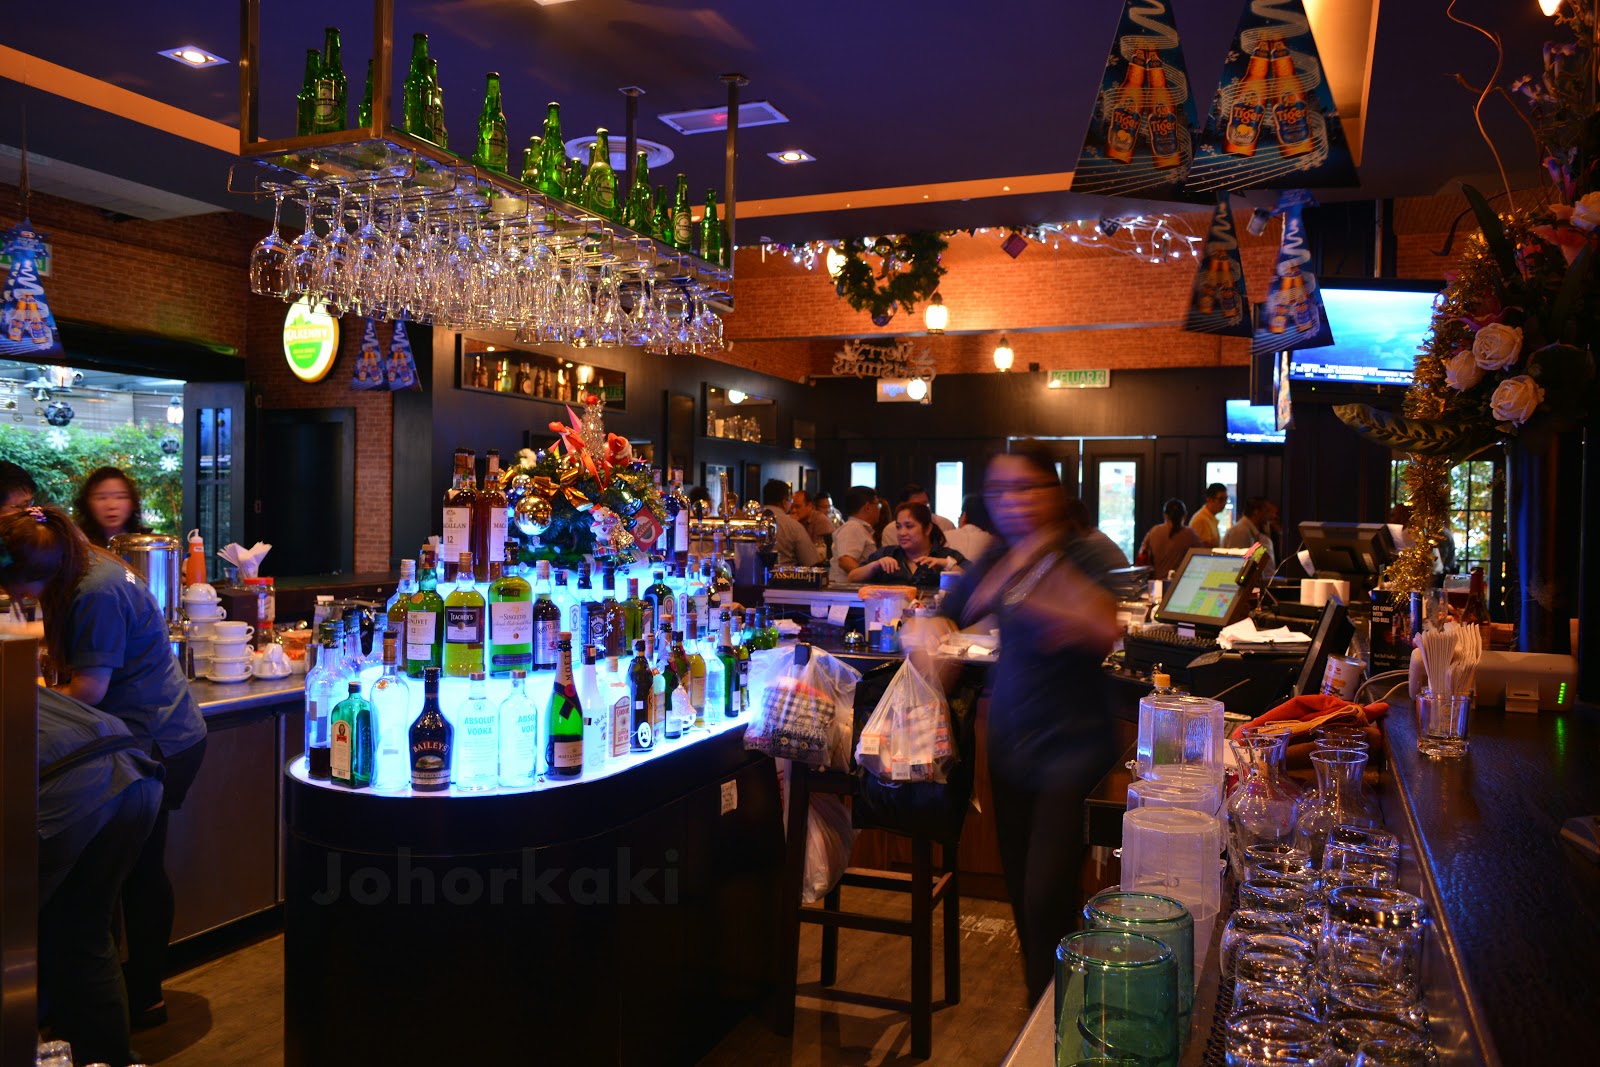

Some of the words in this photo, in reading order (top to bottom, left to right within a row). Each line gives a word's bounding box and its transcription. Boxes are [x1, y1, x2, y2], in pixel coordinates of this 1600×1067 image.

[1114, 111, 1140, 130] Tiger
[1234, 106, 1262, 124] Tiger
[1277, 106, 1306, 124] Tiger
[1151, 119, 1175, 136] Tiger
[1052, 371, 1094, 384] KELUAR
[447, 535, 454, 543] 12
[773, 571, 816, 583] Hennessy
[450, 612, 474, 622] TEACHER'S
[464, 715, 494, 725] ABSOLUT
[467, 727, 492, 735] VODKA
[412, 741, 448, 753] BAILEYS
